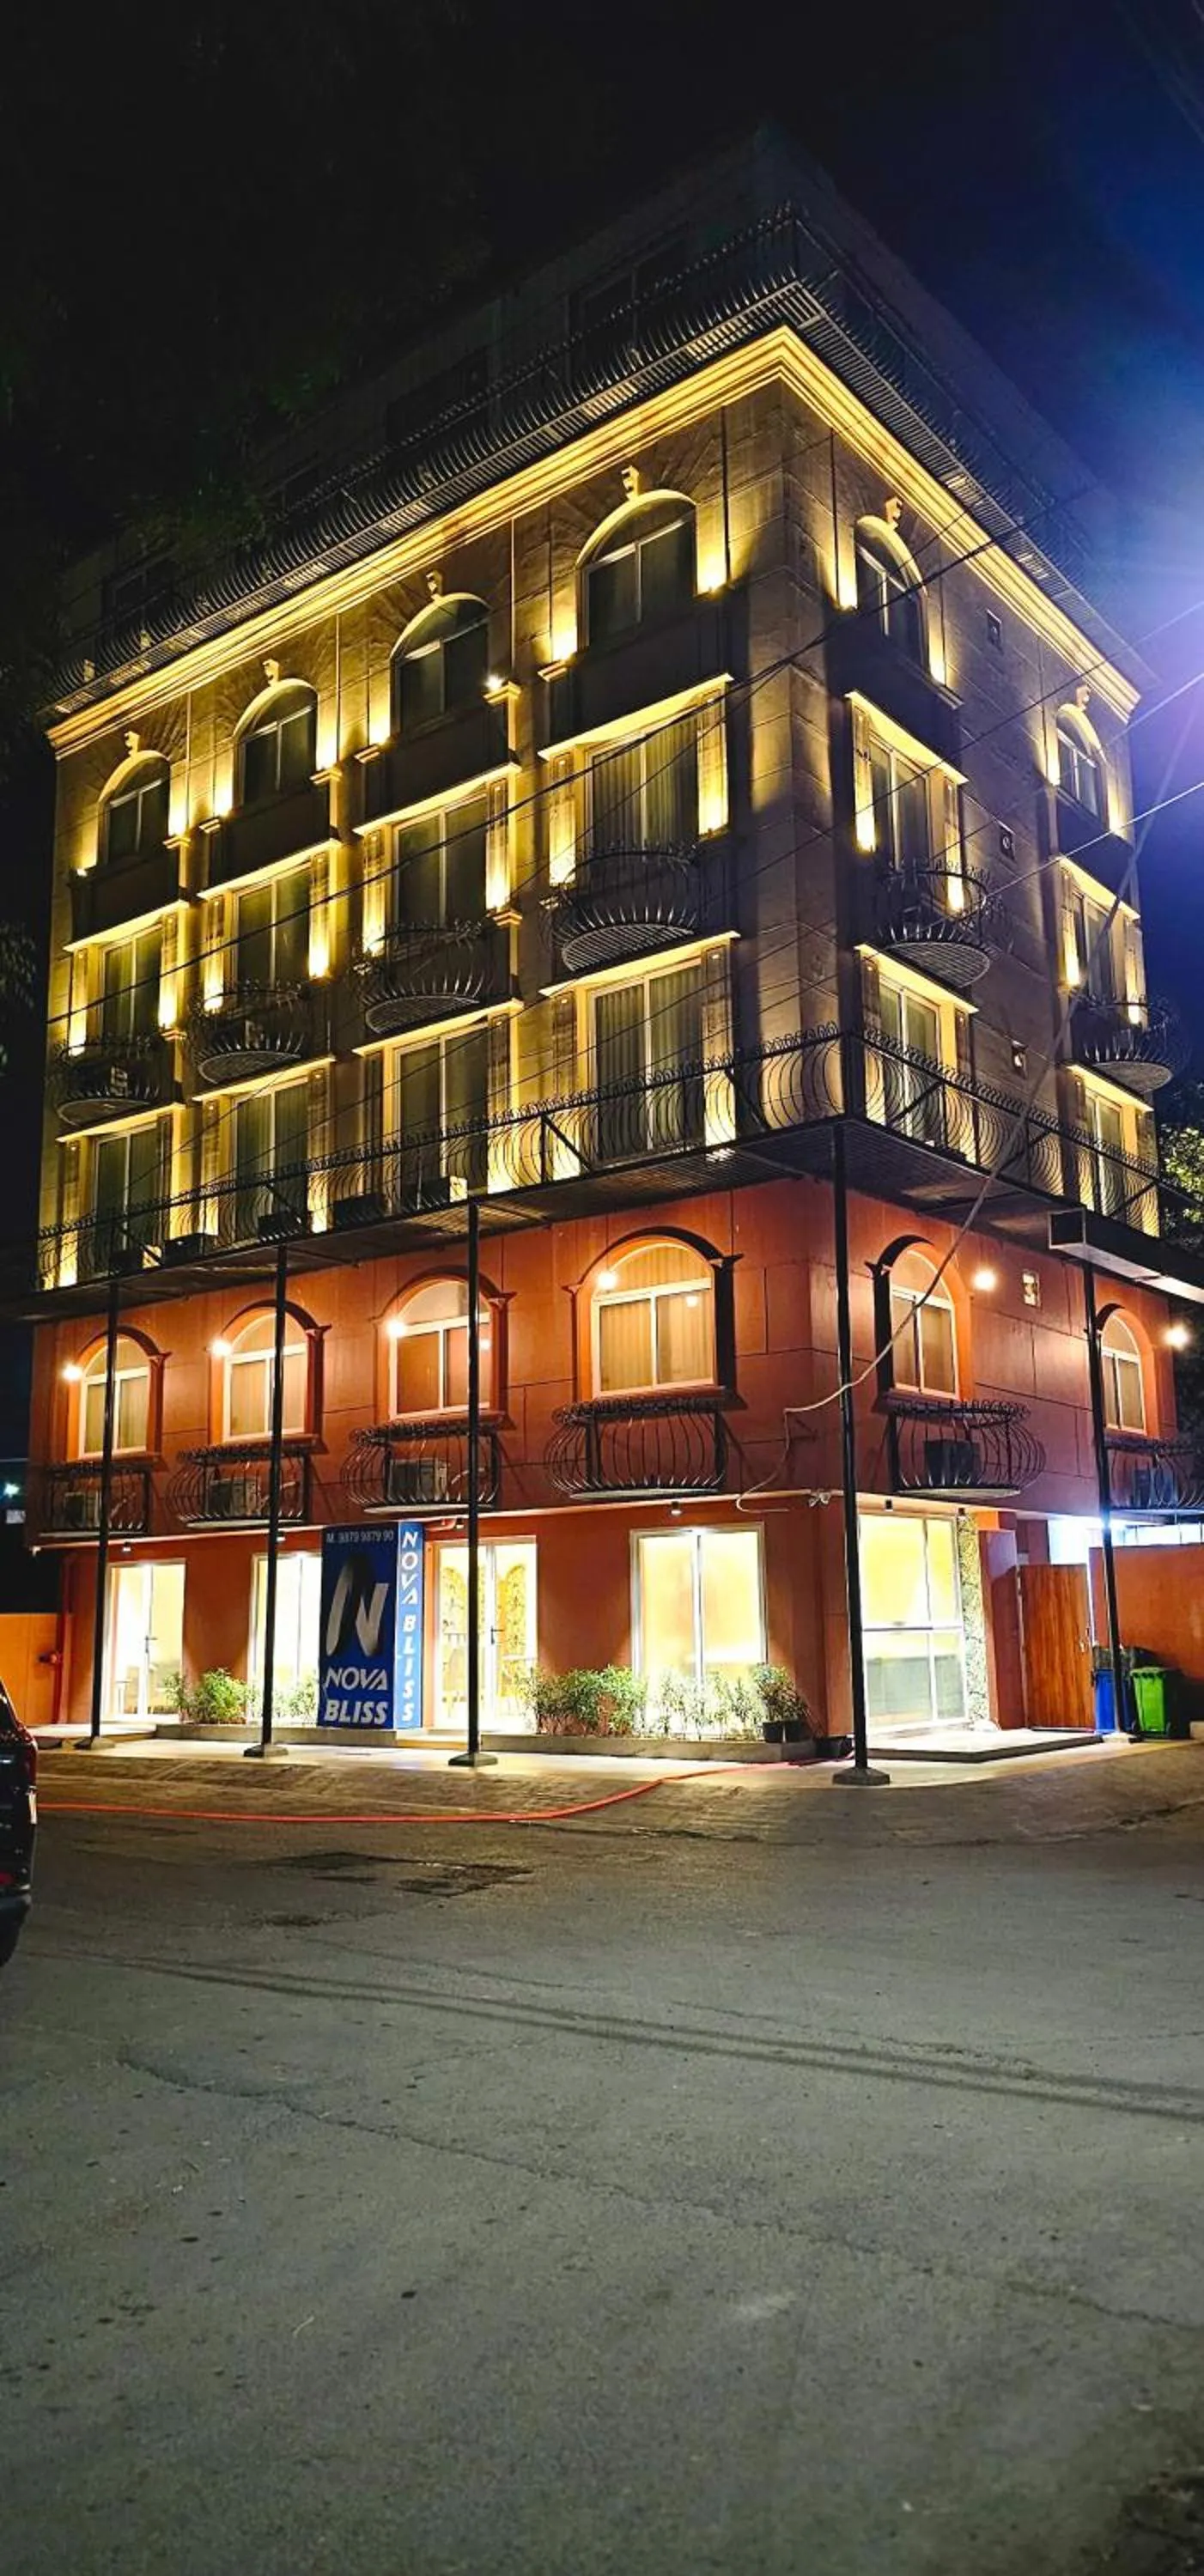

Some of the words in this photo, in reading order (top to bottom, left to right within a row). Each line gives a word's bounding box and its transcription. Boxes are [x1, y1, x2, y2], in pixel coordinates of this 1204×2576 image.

[401, 1531, 418, 1605] NOVA
[325, 1667, 388, 1690] NOVA
[402, 1614, 417, 1722] BLISS
[324, 1699, 388, 1724] BLISS
